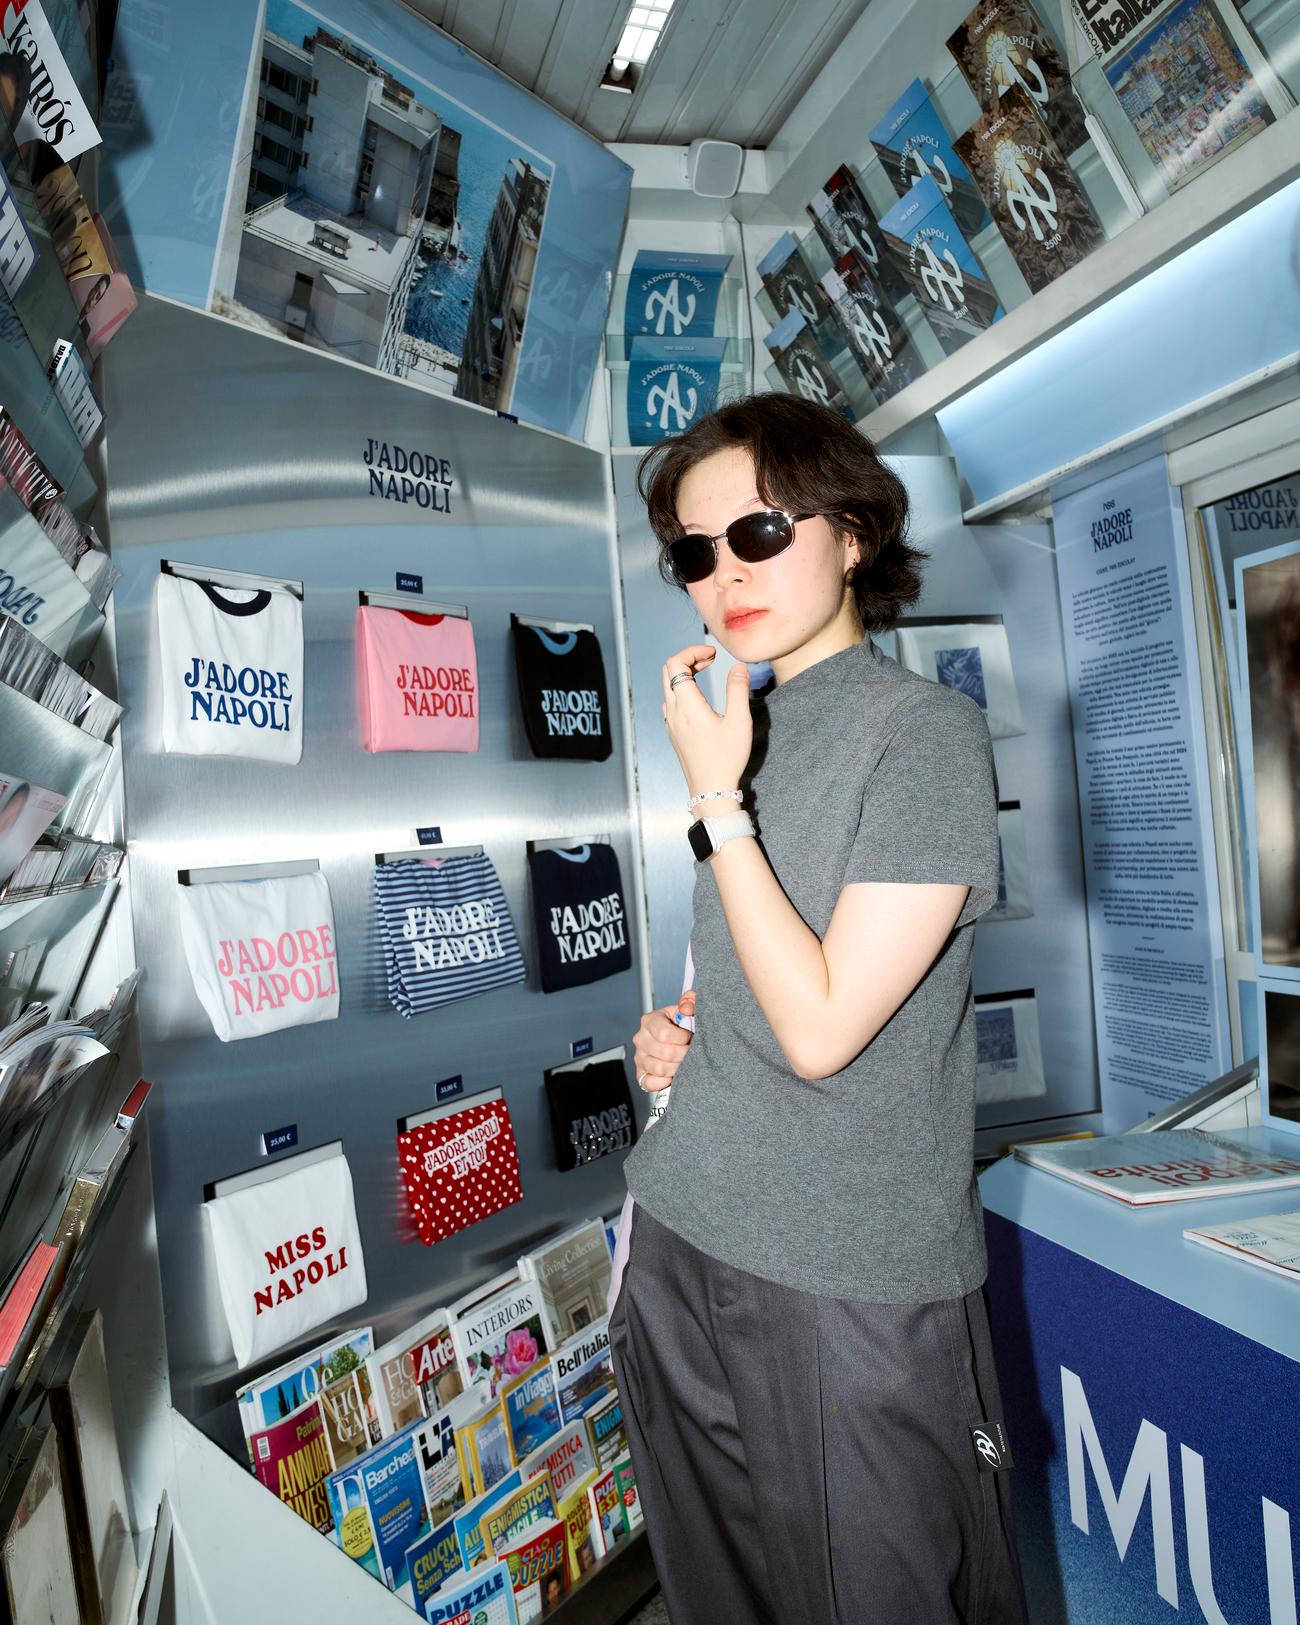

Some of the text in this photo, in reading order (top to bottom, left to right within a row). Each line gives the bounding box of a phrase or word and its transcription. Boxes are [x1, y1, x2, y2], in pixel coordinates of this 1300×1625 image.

[1079, 17, 1103, 60] EDICOLA
[910, 134, 940, 149] NAPOLI
[920, 227, 950, 243] NAPOLI
[641, 271, 706, 293] J'ADORE NAPOLI
[641, 363, 706, 387] J'ADORE NAPOLI
[363, 438, 453, 487] J'ADORE
[368, 468, 452, 514] NAPOLI
[1090, 508, 1133, 538] J'ADORE
[1093, 525, 1134, 553] NAPOLI
[184, 657, 294, 702] J'ADORE
[397, 664, 475, 692] J'ADORE
[190, 690, 291, 732] NAPOLI
[402, 691, 475, 719] NAPOLI
[541, 689, 602, 714] J'ADORE
[545, 713, 603, 736] NAPOLI
[402, 897, 500, 940] J'ADORE
[550, 892, 624, 936] J'ADORE
[217, 924, 337, 977] J'ADORE
[411, 928, 506, 973] NAPOLI
[557, 920, 627, 964] NAPOLI
[229, 960, 338, 1016] NAPOLI
[426, 1117, 500, 1172] J'ADORE NAPOLI
[570, 1103, 632, 1145] J'ADORE
[454, 1146, 487, 1178] ET TOI
[264, 1226, 327, 1275] MISS
[253, 1246, 349, 1316] NAPOLI
[466, 1294, 533, 1347] INTERIORS
[417, 1338, 455, 1386] Arte
[556, 1333, 609, 1379] Bell'Italia
[489, 1481, 550, 1539] ENIGMISTICA
[506, 1507, 540, 1540] FACILE
[431, 1572, 505, 1625] PUZZLE
